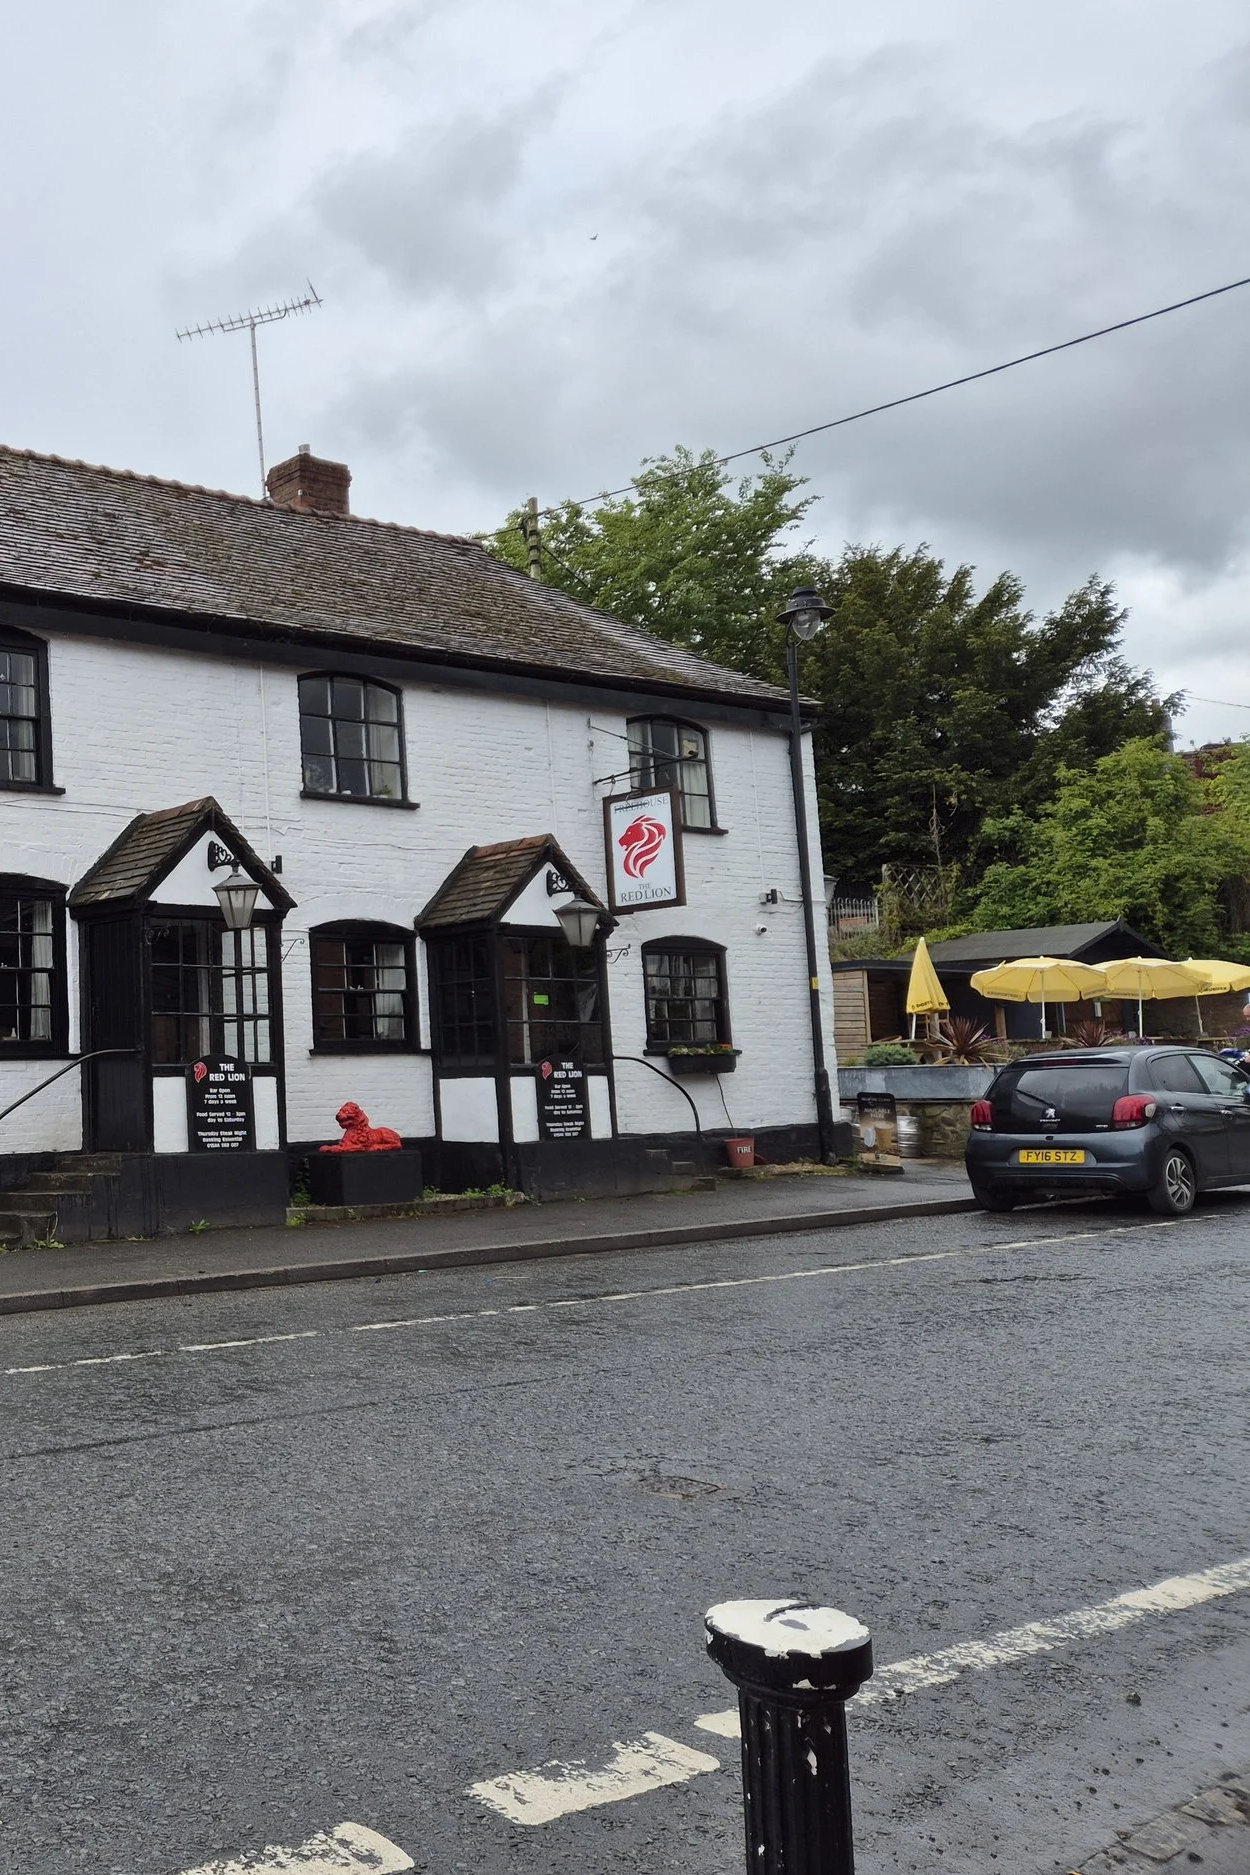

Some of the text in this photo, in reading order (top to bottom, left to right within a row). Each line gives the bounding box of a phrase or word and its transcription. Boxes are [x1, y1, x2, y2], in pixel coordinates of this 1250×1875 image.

[639, 883, 650, 891] THE
[621, 887, 671, 903] RED LION
[219, 1063, 234, 1071] THE
[209, 1073, 246, 1081] RED LION
[568, 1070, 583, 1078] LION
[737, 1146, 752, 1154] FIRE
[1026, 1151, 1077, 1162] FY16 STZ
